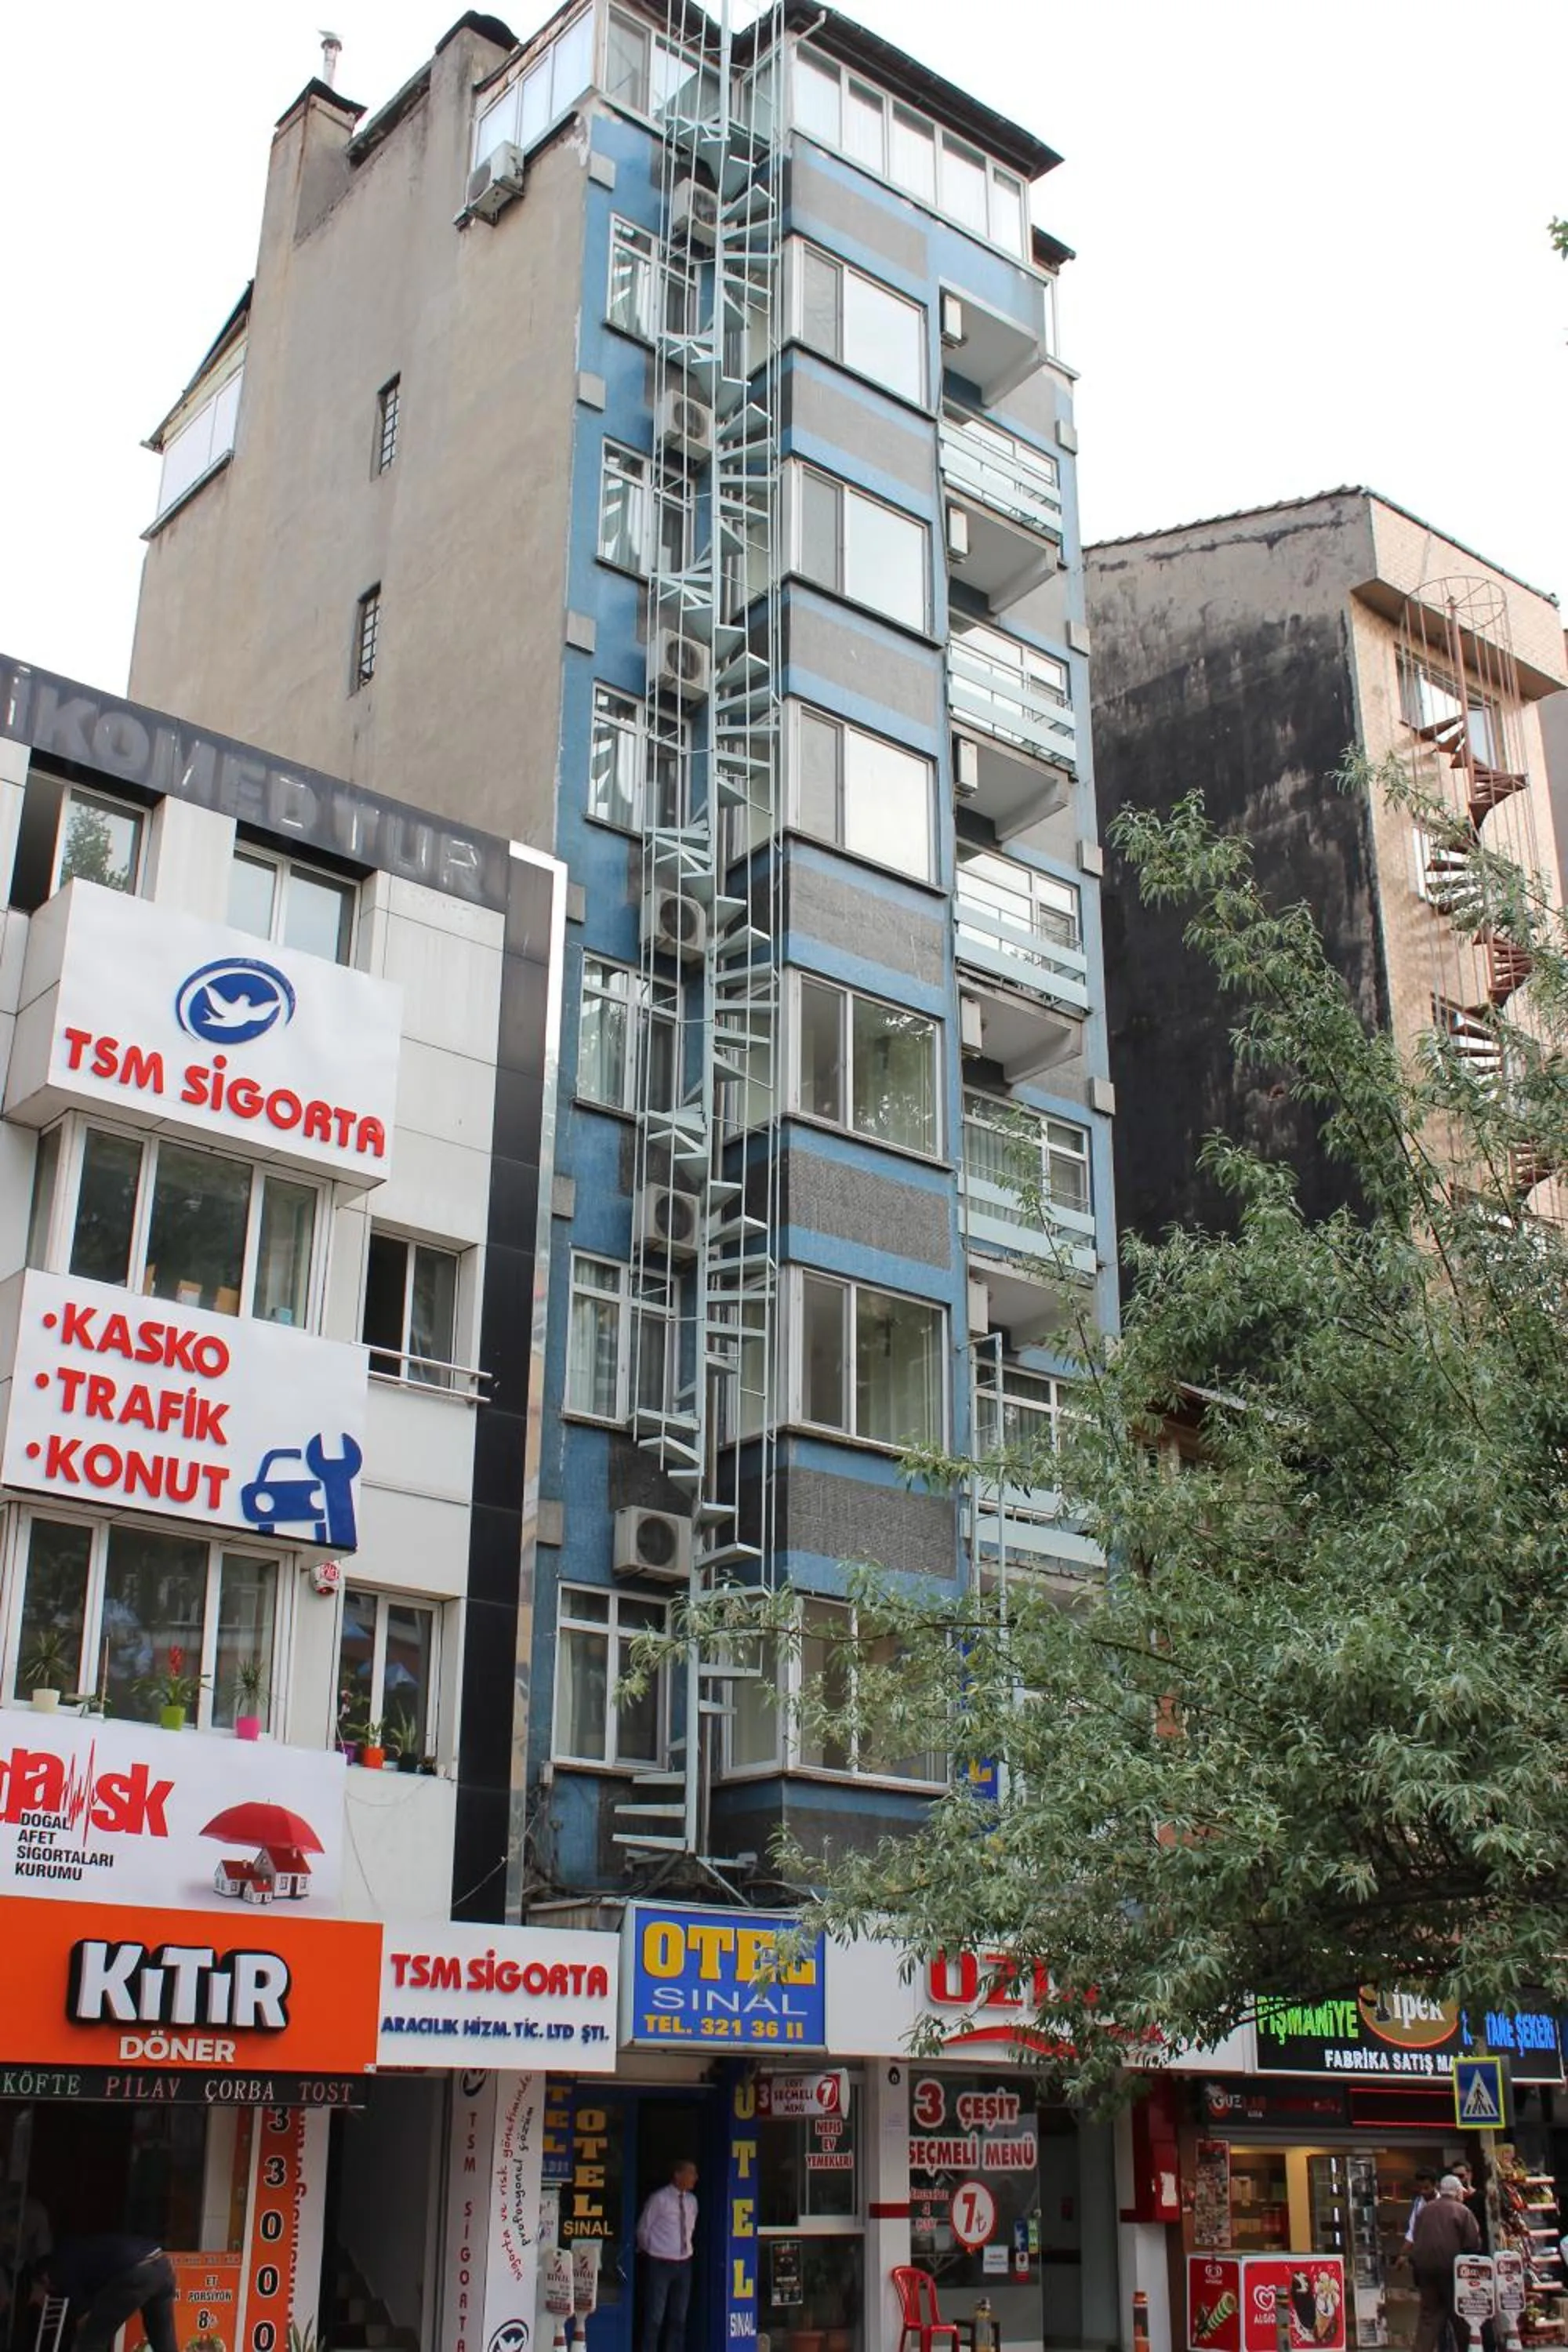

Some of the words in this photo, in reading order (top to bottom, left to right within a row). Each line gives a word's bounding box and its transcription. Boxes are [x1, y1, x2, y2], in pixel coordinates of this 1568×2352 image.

[64, 1027, 164, 1095] TSM
[180, 1054, 386, 1158] SİGORTA
[61, 1301, 230, 1378] KASKO
[57, 1367, 230, 1445] TRAFİK
[45, 1435, 230, 1510] KONUT
[17, 1829, 57, 1845] AFET
[20, 1812, 71, 1831] DOĞAL
[15, 1862, 83, 1881] KURUMU
[16, 1843, 114, 1867] SİGORTALARI
[643, 1921, 816, 1986] OTEL
[390, 1953, 462, 1990] TSM
[467, 1949, 608, 1998] SİGORTA
[652, 1987, 808, 2016] SINAL
[381, 2016, 459, 2036] ARACILIK
[463, 2016, 512, 2038] HİZM.
[547, 2023, 575, 2040] LTD
[644, 2014, 692, 2034] TEL.
[701, 2017, 742, 2036] 321
[752, 2020, 779, 2038] 36
[119, 2029, 236, 2063] DÖNER
[1324, 2046, 1390, 2071] FABRİKA
[1392, 2052, 1434, 2076] SATIŞ
[2, 2071, 82, 2096] KÖFTE
[104, 2074, 182, 2100] PİLAV
[205, 2080, 275, 2103] ÇORBA
[299, 2082, 354, 2103] TOST
[821, 2081, 833, 2107] 7
[916, 2082, 944, 2125] 3
[959, 2089, 1018, 2128] ÇEŞİT
[573, 2108, 608, 2218] OTEL
[909, 2134, 978, 2169] SEÇMELİ
[985, 2136, 1034, 2166] MENÜ
[562, 2220, 614, 2236] SINAL
[962, 2192, 978, 2234] 7
